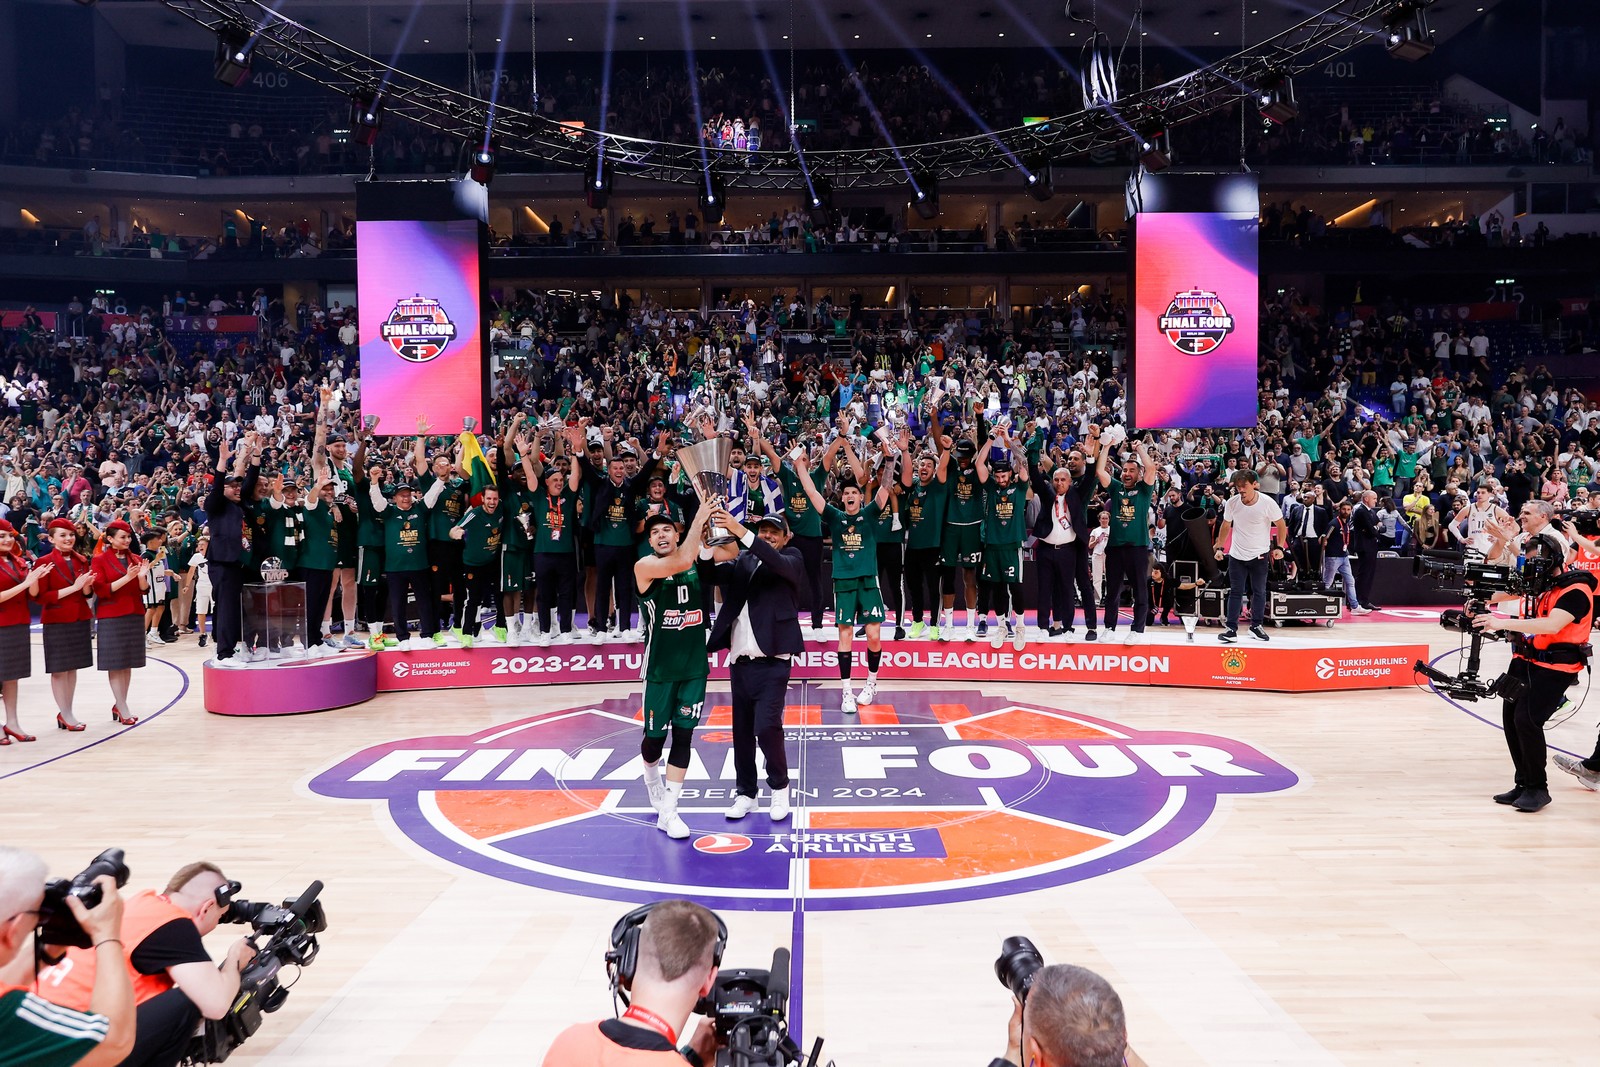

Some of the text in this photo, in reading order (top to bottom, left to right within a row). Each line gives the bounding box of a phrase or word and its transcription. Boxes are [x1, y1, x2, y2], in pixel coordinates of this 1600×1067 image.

[1323, 62, 1356, 78] 401
[252, 72, 288, 88] 406
[1160, 316, 1232, 328] FINAL FOUR
[383, 323, 454, 336] FINAL FOUR
[970, 552, 982, 563] 37
[1008, 566, 1015, 576] 2
[1577, 562, 1600, 570] MED
[677, 585, 689, 604] 10
[441, 660, 471, 668] AIRLINES
[491, 654, 604, 675] 2023-24
[851, 651, 1014, 669] EUROLEAGUE
[1020, 653, 1170, 673] CHAMPION
[1338, 657, 1408, 667] TURKISH AIRLINES
[411, 668, 457, 677] EuroLeague
[1337, 667, 1391, 678] EuroLeague
[841, 745, 1266, 780] FOUR
[678, 786, 926, 799] BELN 2024
[769, 833, 911, 843] TURKISH
[765, 843, 917, 853] AIRLINES
